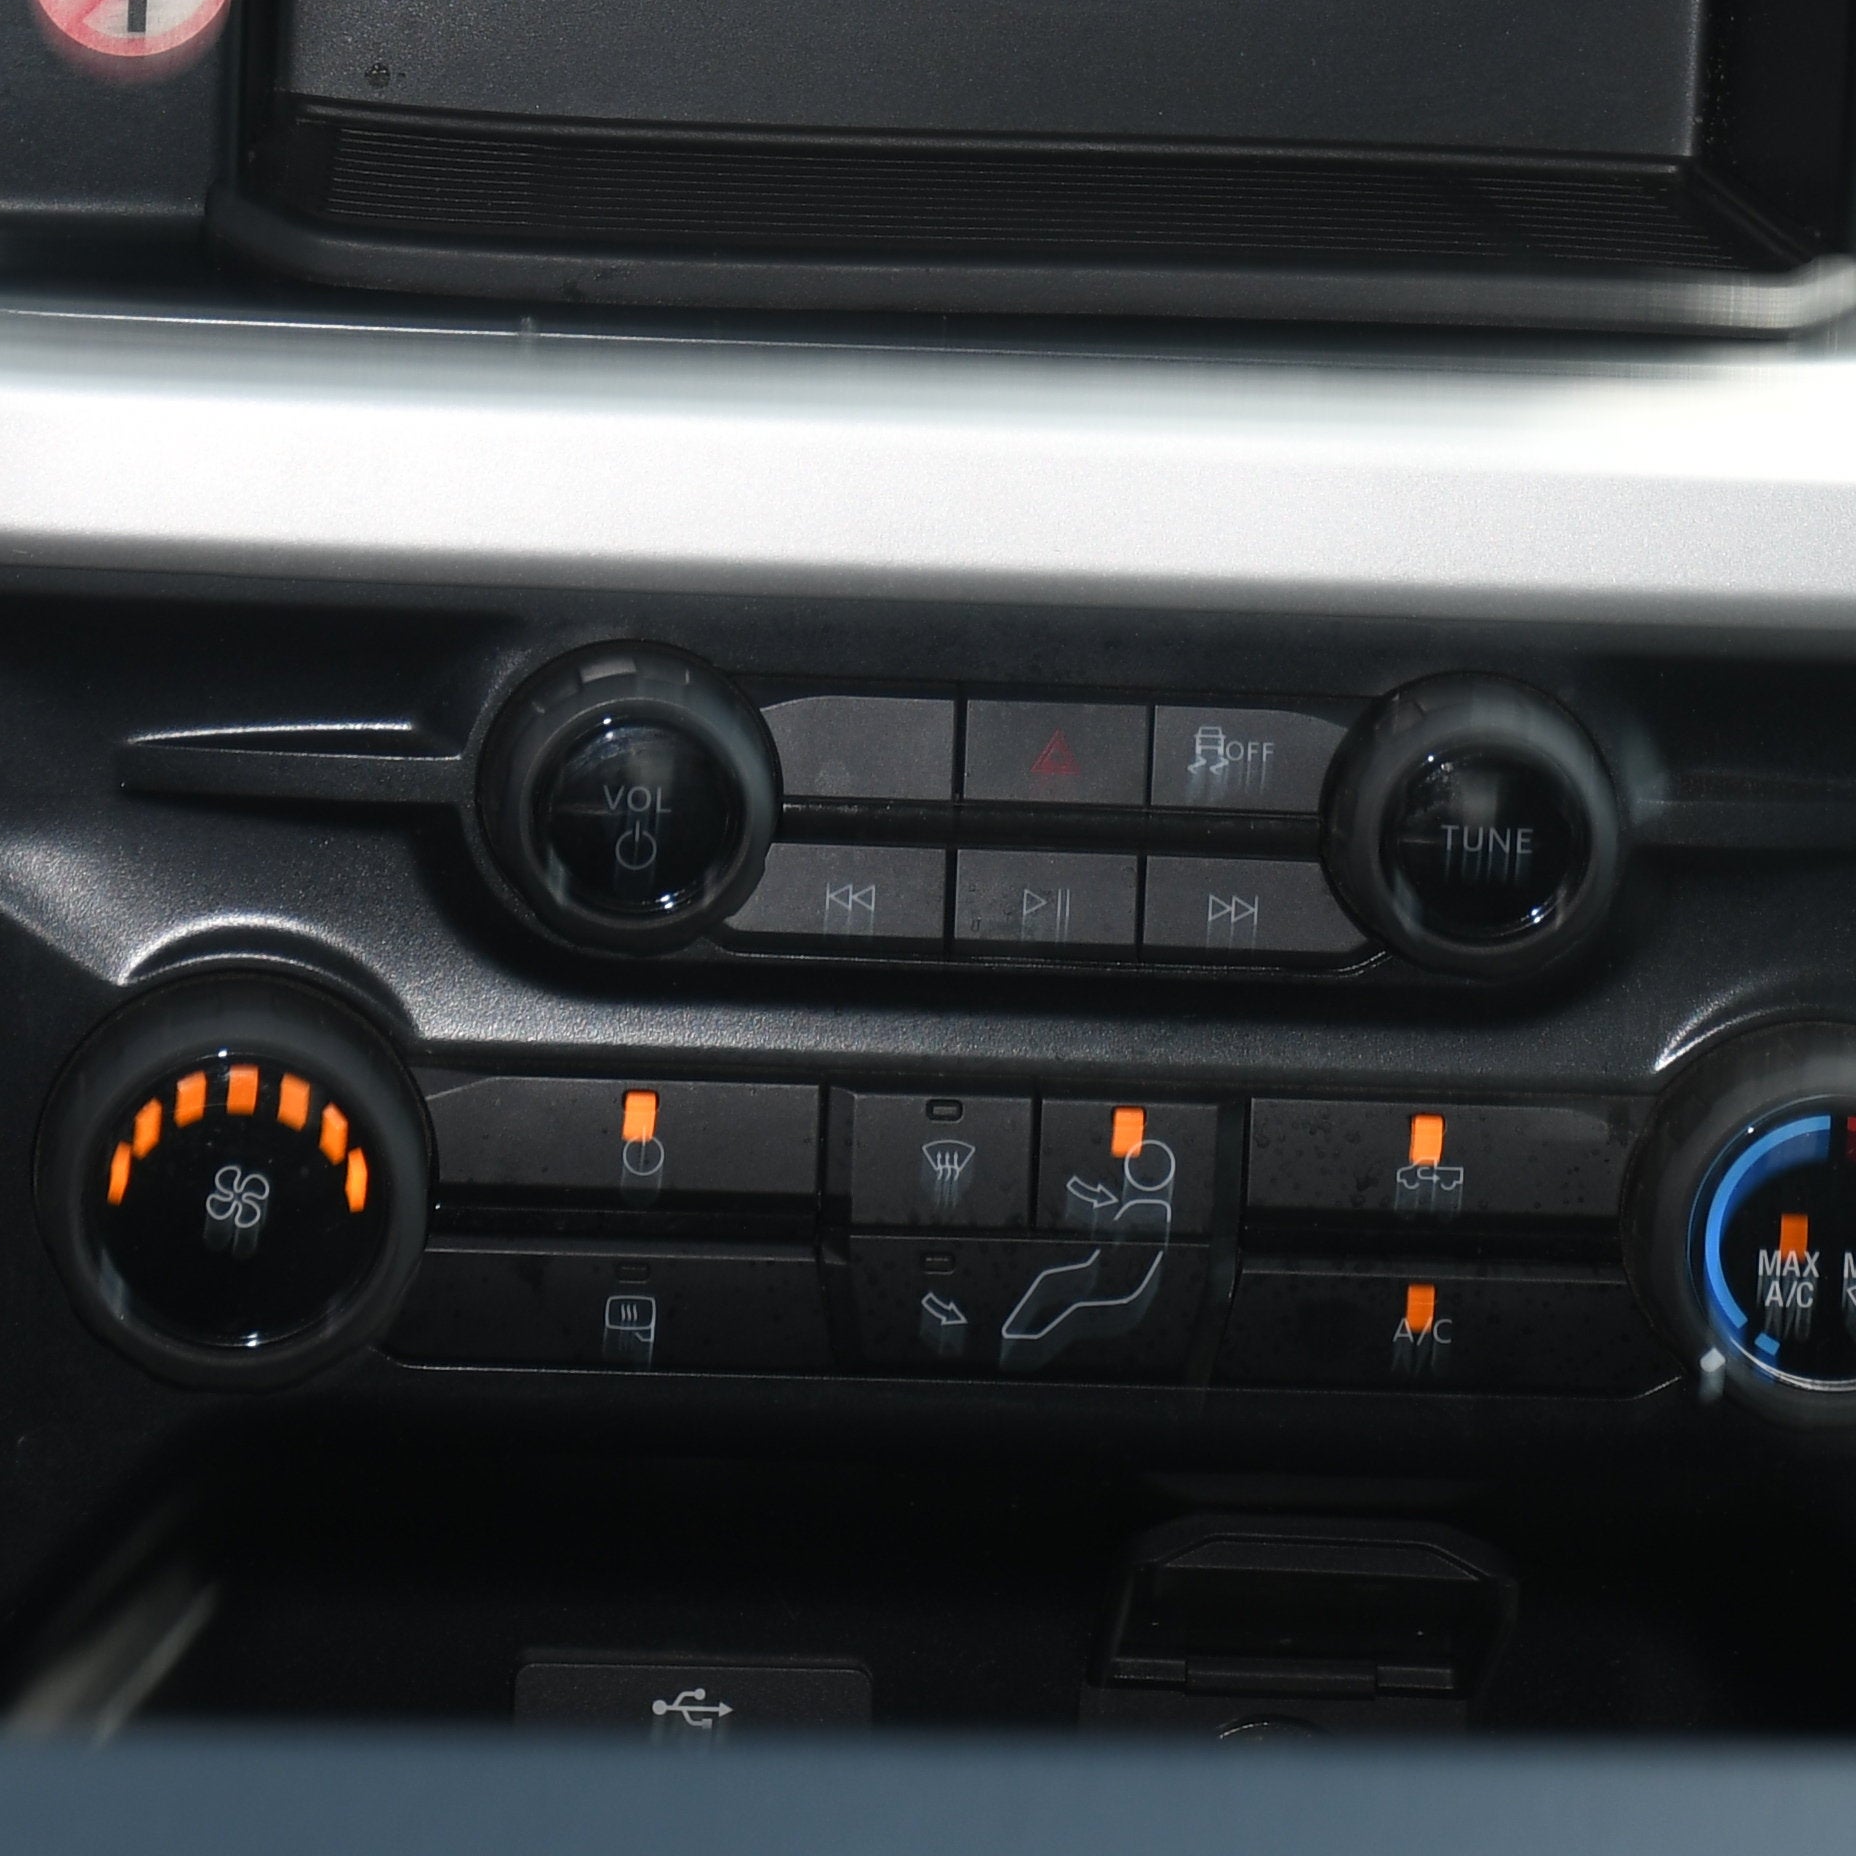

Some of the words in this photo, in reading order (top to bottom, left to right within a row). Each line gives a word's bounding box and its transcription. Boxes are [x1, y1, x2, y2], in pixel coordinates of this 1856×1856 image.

[1225, 740, 1275, 762] OFF
[603, 784, 672, 813] VOL
[1441, 824, 1533, 854] TUNE
[1758, 1249, 1820, 1278] MAX
[1764, 1281, 1815, 1308] A/C
[1392, 1317, 1453, 1346] A/C
